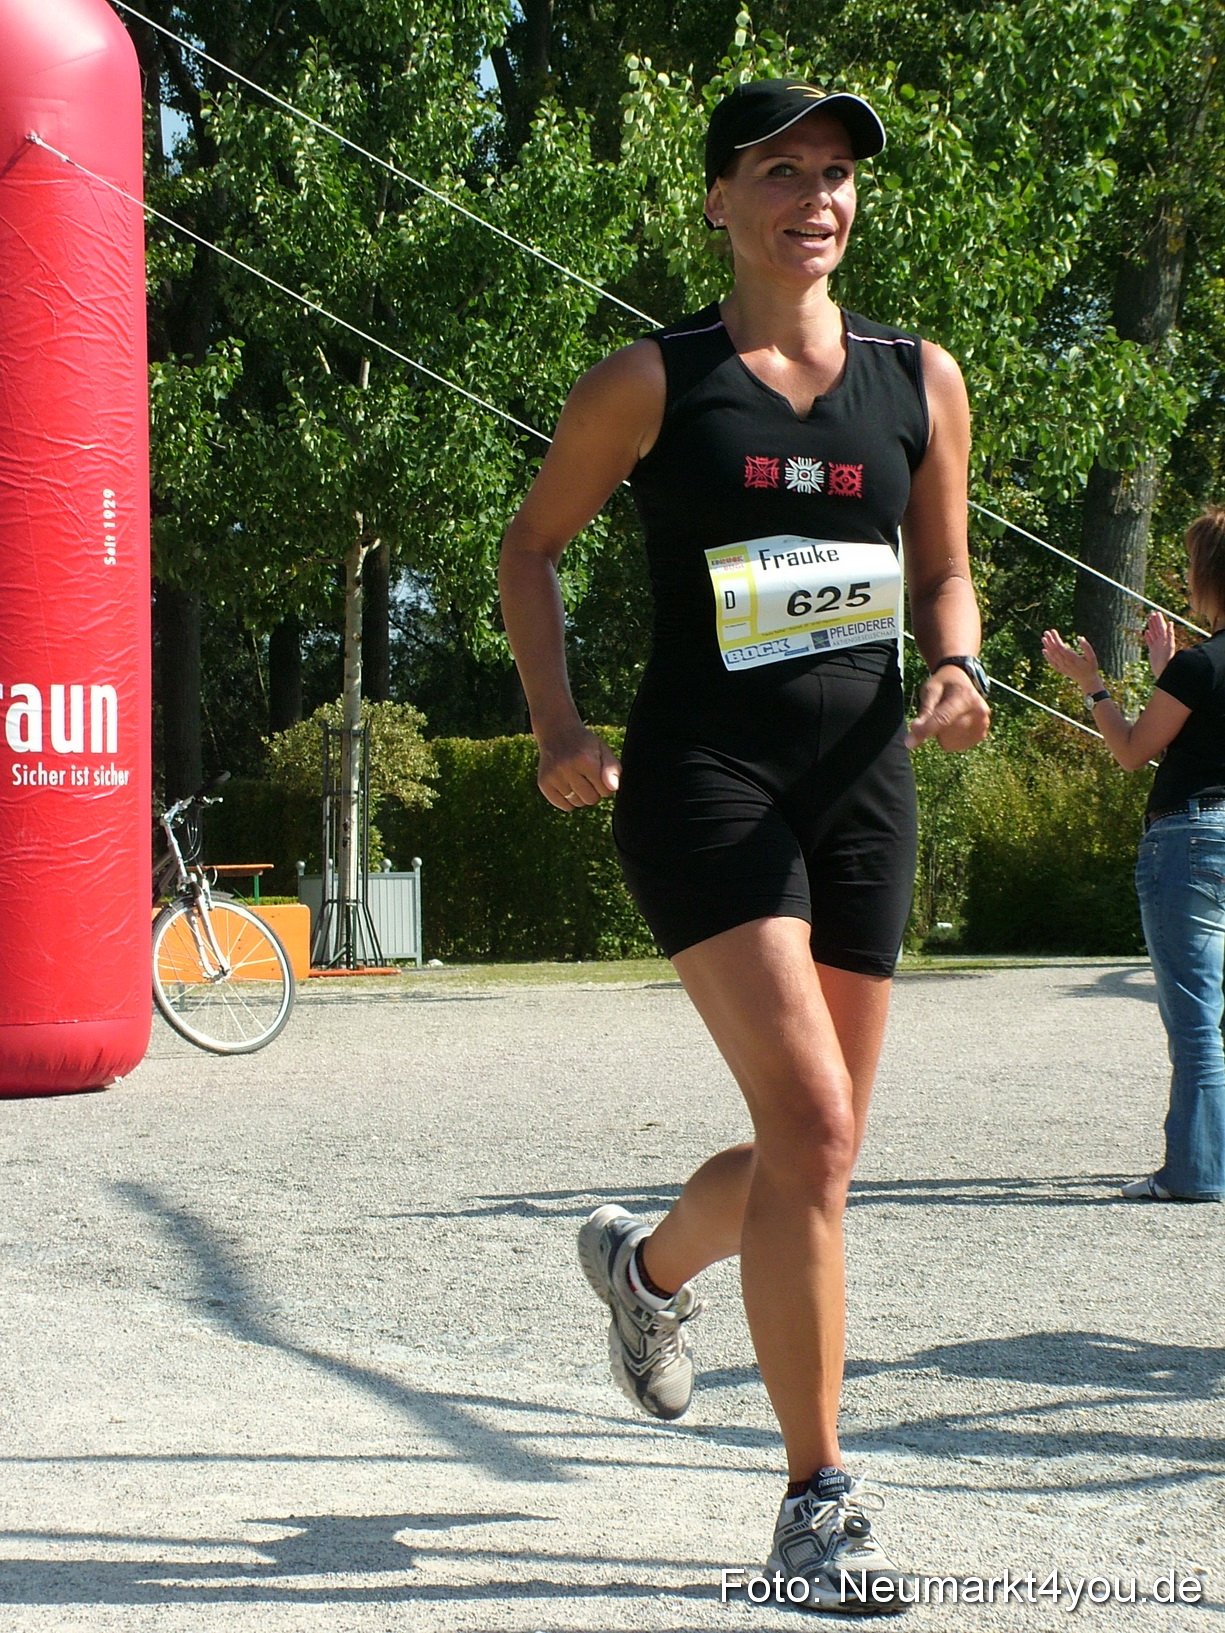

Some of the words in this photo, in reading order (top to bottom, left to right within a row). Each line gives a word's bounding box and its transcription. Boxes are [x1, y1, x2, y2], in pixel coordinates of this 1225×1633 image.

[103, 488, 117, 528] 1929
[103, 535, 117, 566] Seit
[758, 544, 840, 571] Frauke
[724, 590, 736, 610] D
[786, 581, 872, 618] 625
[829, 617, 896, 639] PFLEIDERER
[724, 638, 791, 665] BOCK
[0, 683, 118, 754] aun
[11, 761, 67, 786] Sicher
[71, 764, 90, 786] ist
[93, 761, 130, 786] sicher
